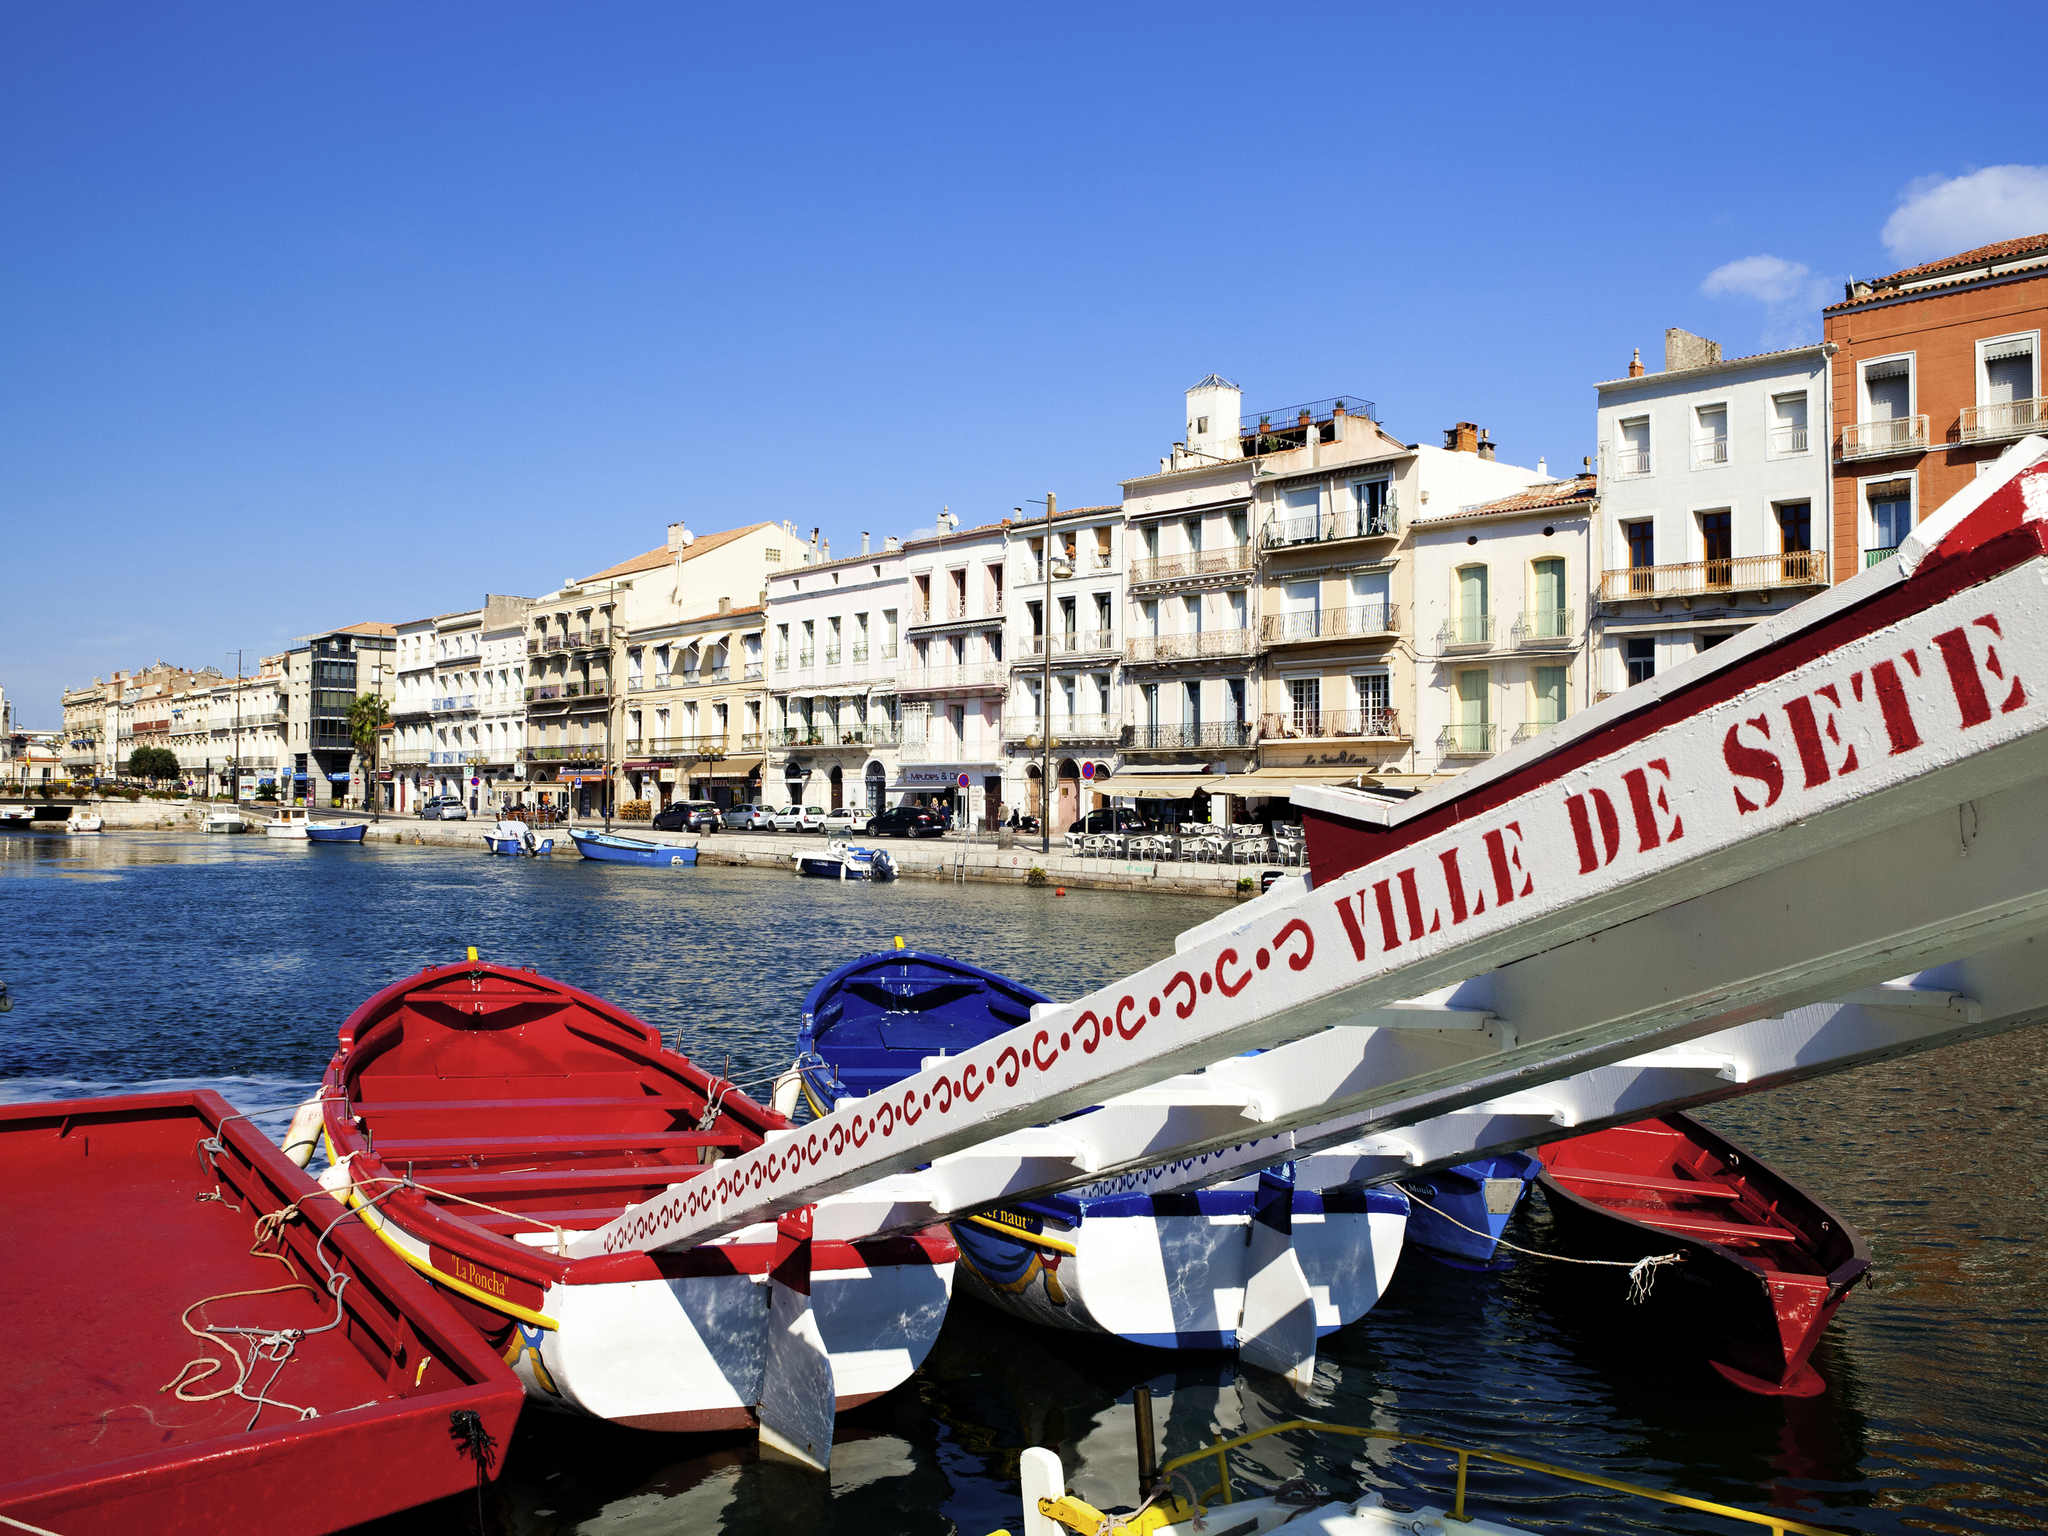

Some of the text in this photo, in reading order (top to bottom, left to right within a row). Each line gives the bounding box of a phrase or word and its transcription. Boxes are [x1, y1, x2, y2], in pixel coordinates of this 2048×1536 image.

[1334, 612, 2029, 962] VILLE DE SETE
[469, 1263, 509, 1297] Poncha"
